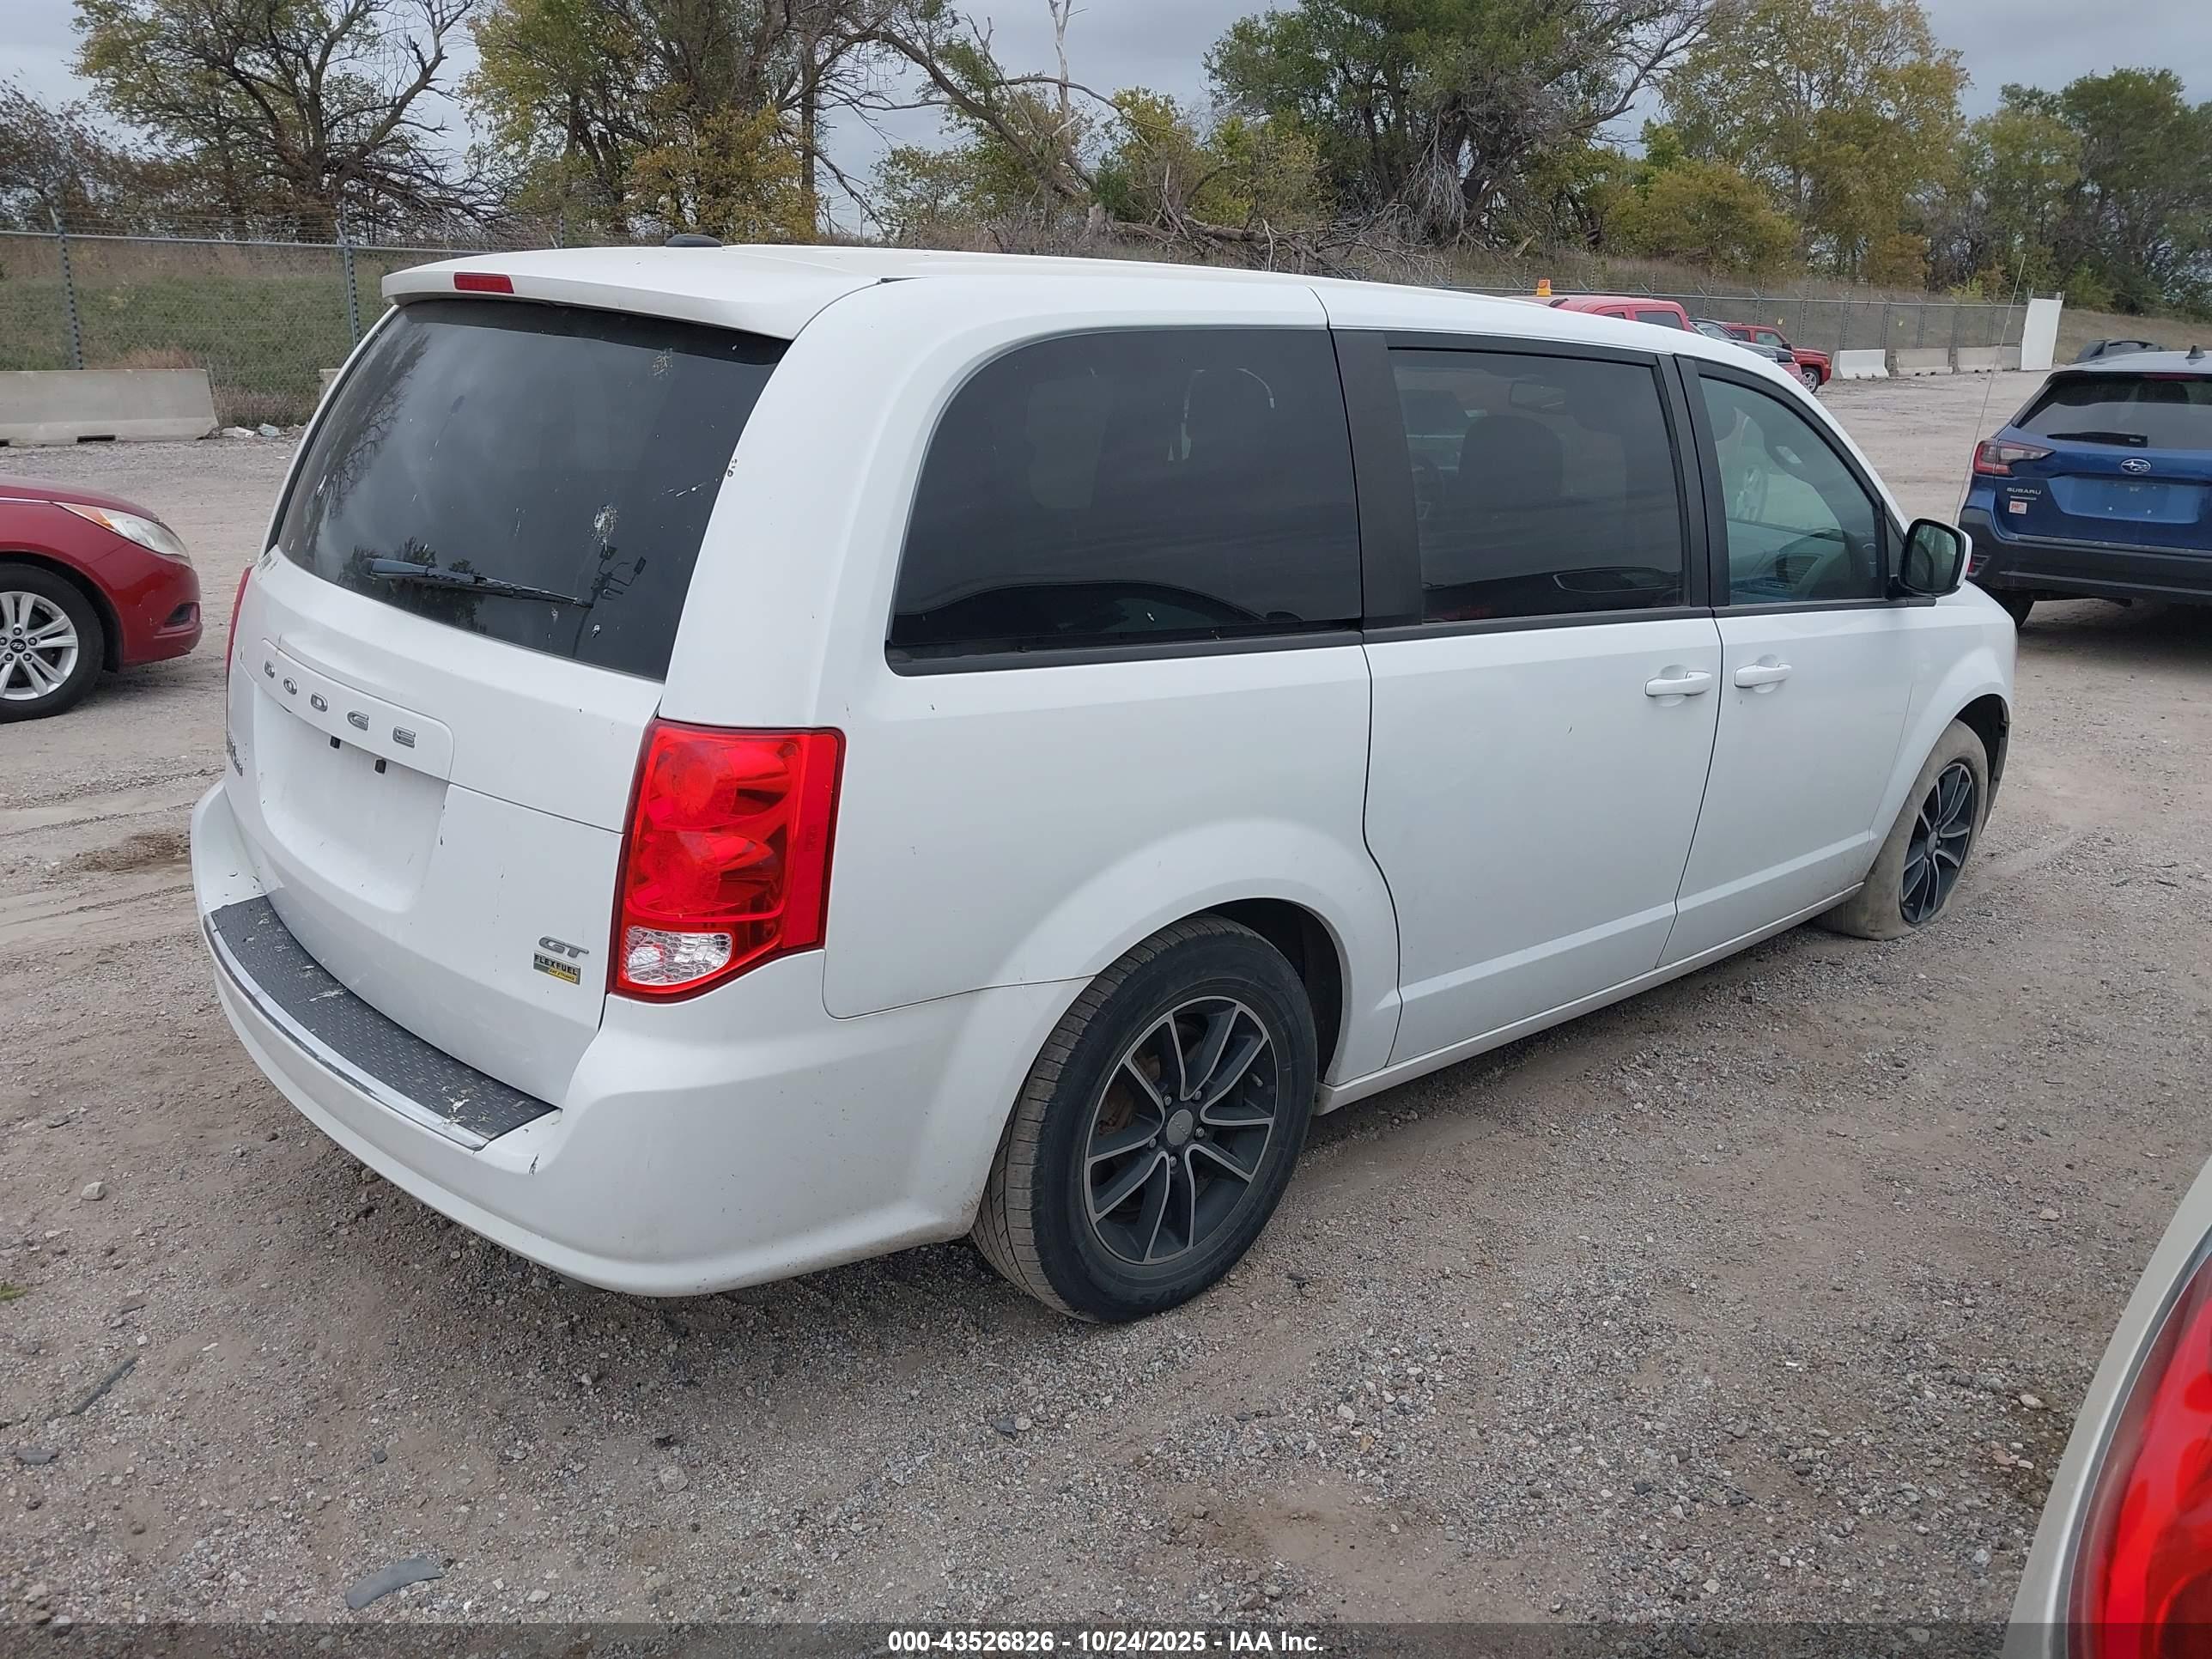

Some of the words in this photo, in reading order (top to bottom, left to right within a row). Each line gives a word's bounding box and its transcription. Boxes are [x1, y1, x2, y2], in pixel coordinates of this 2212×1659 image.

[2006, 487, 2042, 495] SUBARU
[264, 659, 417, 749] DODGE
[538, 936, 590, 958] GT
[534, 953, 579, 976] FLEXFUEL
